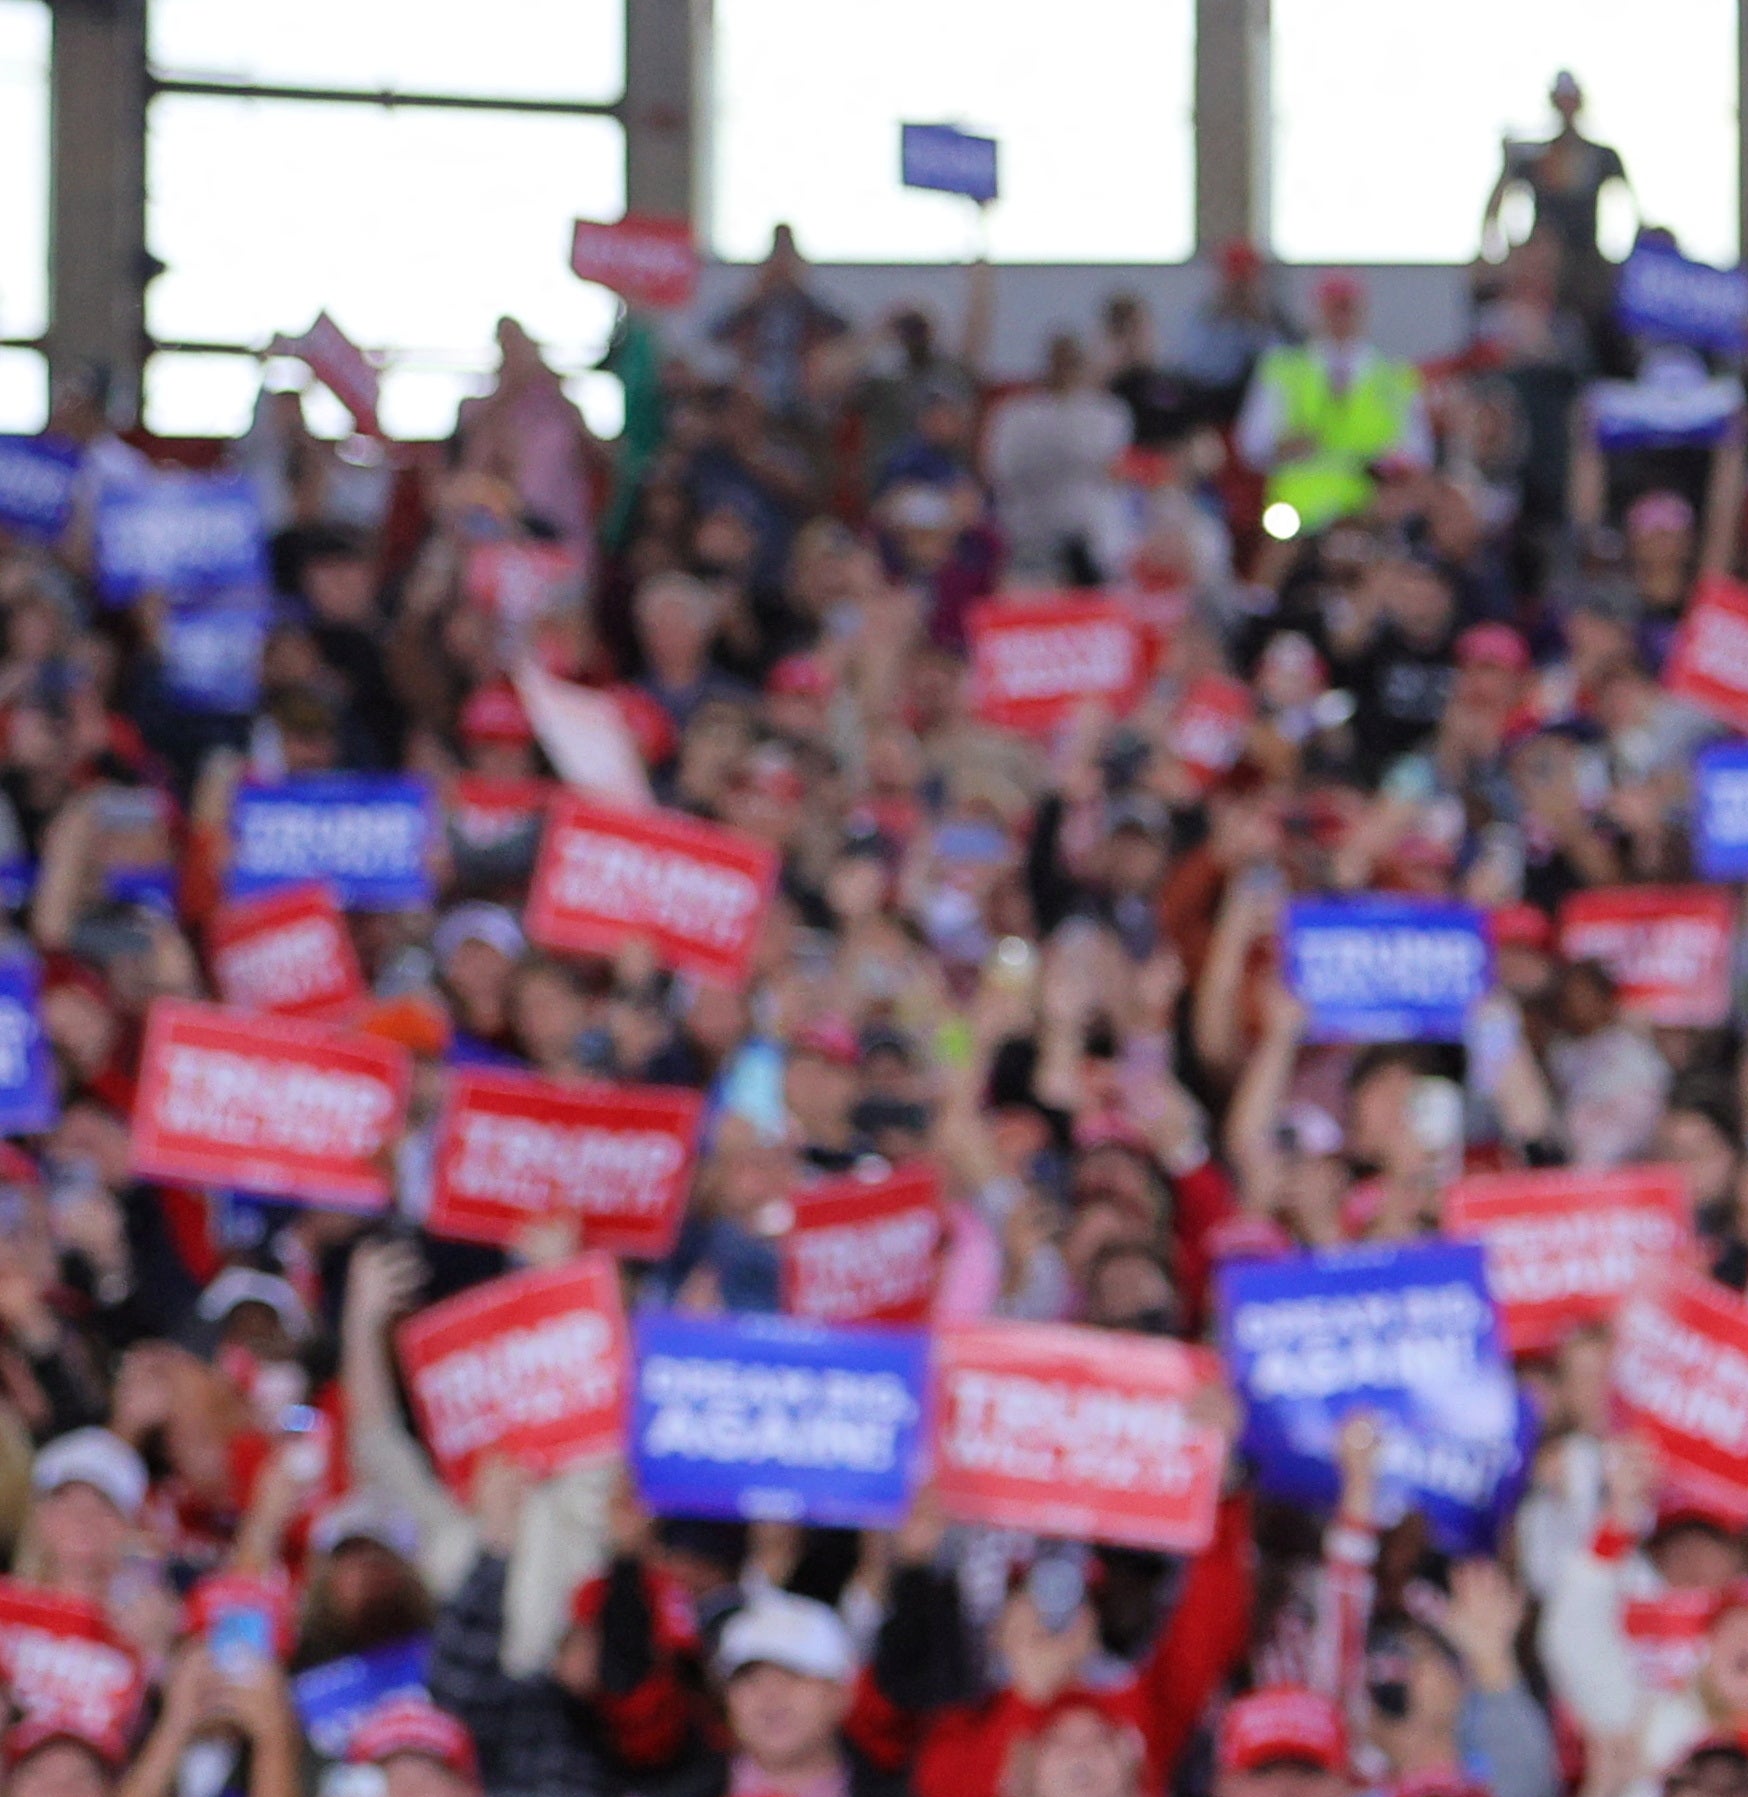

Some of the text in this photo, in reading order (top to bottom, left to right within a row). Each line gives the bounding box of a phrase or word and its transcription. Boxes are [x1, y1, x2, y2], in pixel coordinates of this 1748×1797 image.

[163, 1041, 393, 1118] TRUMP
[459, 1110, 685, 1175] TRUMP
[416, 1309, 612, 1406] TRUMP
[642, 1354, 920, 1424] DREAM BIG,
[643, 1403, 898, 1475] AGAIN!
